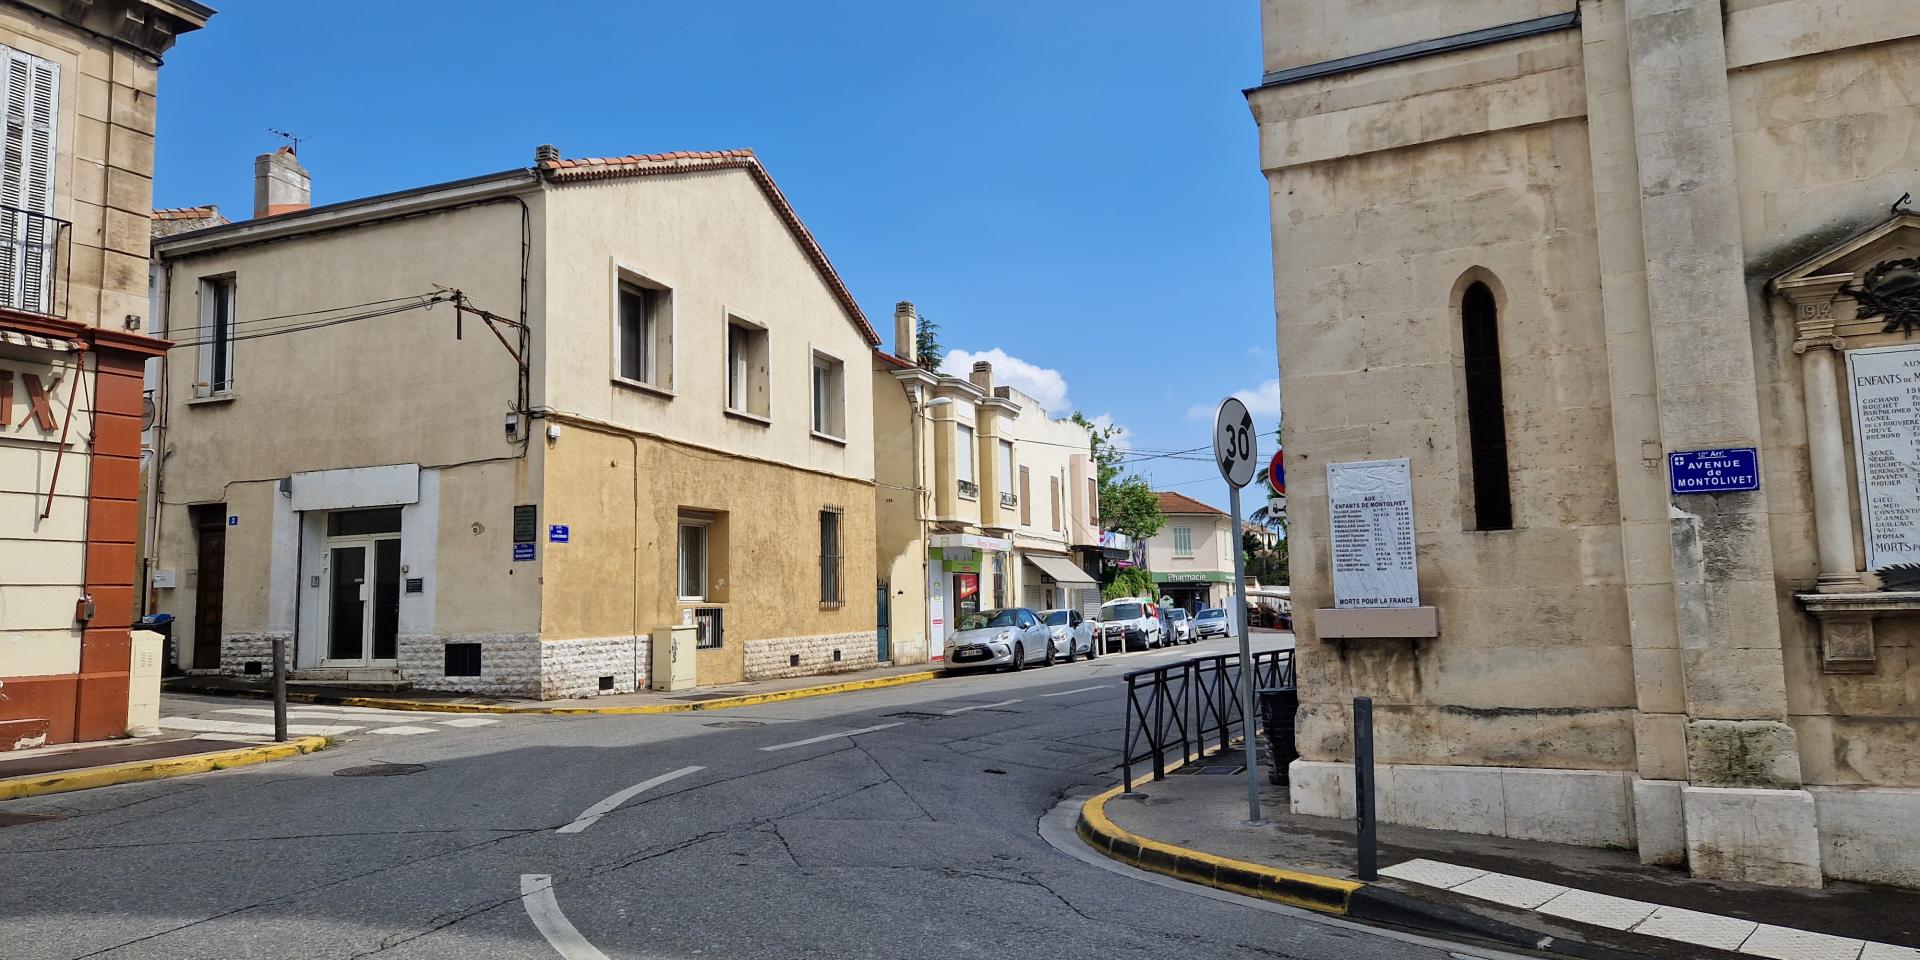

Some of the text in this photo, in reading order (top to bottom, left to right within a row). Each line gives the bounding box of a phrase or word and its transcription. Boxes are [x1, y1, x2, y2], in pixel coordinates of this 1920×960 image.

[1800, 303, 1831, 320] 1914
[1857, 374, 1902, 387] ENFANTS
[1225, 424, 1250, 461] 30
[1688, 459, 1741, 470] AVENUE
[1678, 475, 1753, 487] MONTOLIVET
[1370, 500, 1407, 508] MONTOLIVET
[1875, 542, 1912, 552] MORTS
[1168, 573, 1207, 582] Pharmacie
